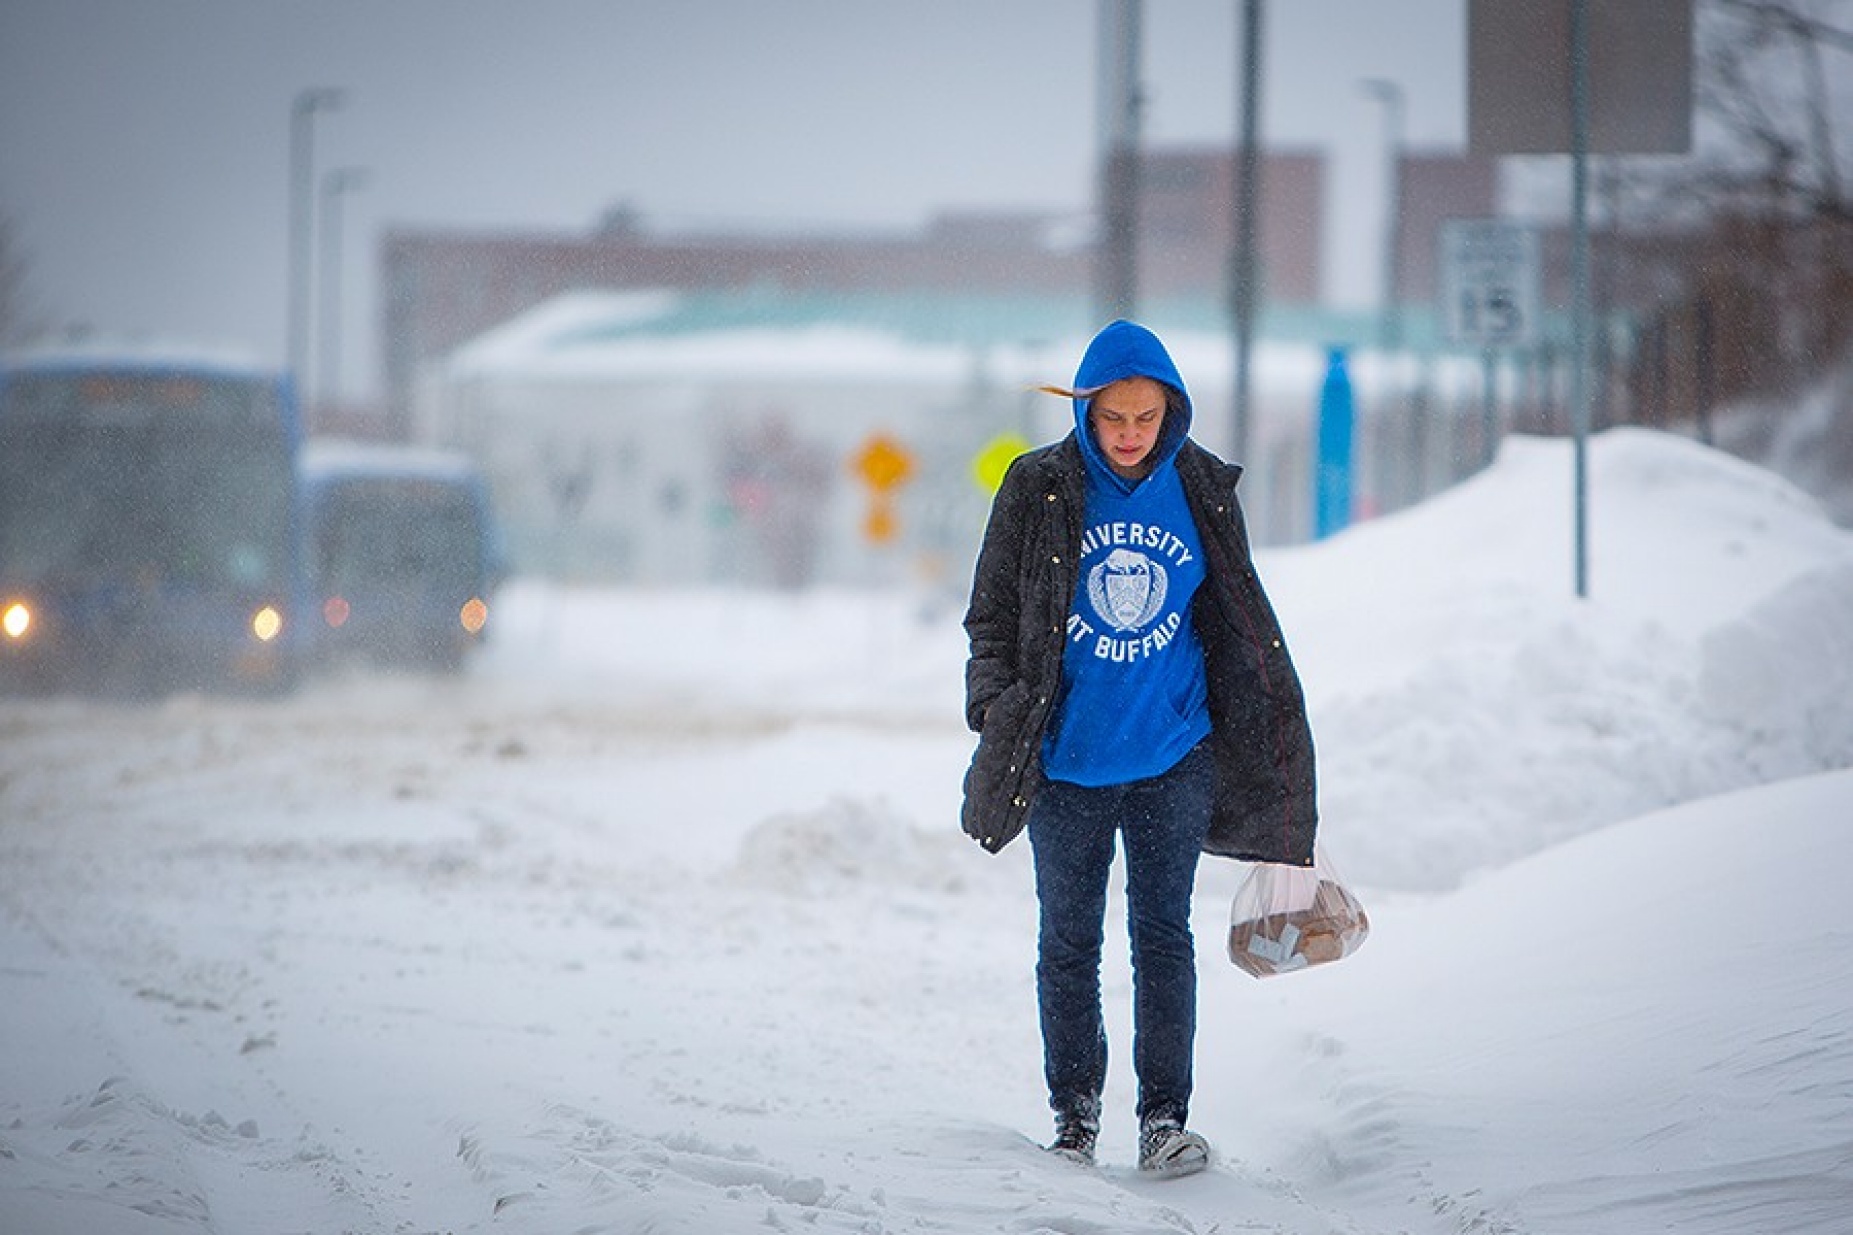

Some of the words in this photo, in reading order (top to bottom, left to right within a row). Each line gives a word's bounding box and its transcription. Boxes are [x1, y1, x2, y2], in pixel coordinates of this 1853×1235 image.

[1080, 522, 1193, 567] NIVERSITY
[1066, 613, 1094, 642] AT
[1094, 611, 1181, 663] BUFFALO
